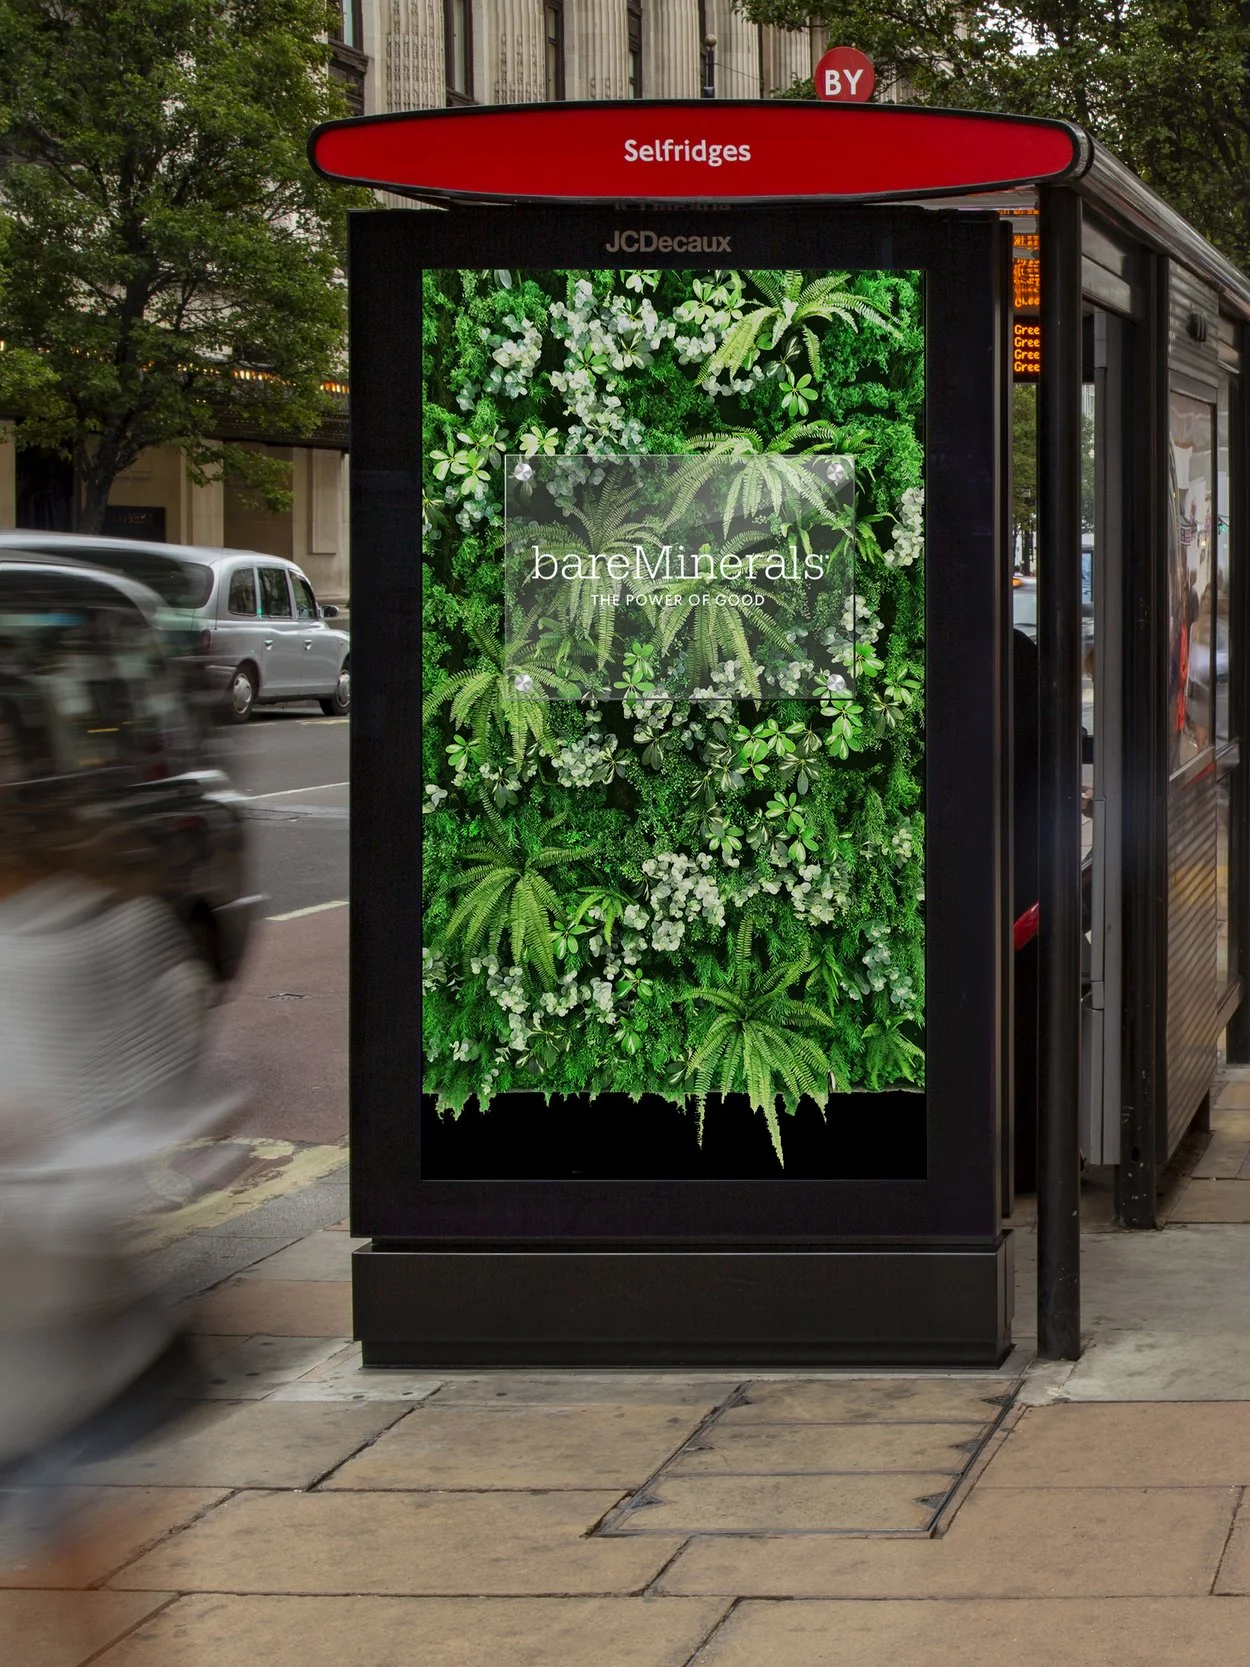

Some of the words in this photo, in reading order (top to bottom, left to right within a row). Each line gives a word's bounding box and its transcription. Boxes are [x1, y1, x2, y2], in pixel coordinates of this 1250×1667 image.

[825, 69, 864, 96] BY
[624, 139, 751, 167] Selfridges
[605, 230, 732, 253] JCDecaux
[1014, 324, 1041, 335] Gree
[1014, 336, 1041, 348] Gree
[1014, 349, 1041, 360] Gree
[1014, 361, 1041, 373] Gree
[531, 545, 825, 580] bareMinerals
[591, 594, 620, 606] THE
[626, 594, 682, 606] POWER
[688, 594, 710, 606] OF
[715, 594, 765, 606] GOOD
